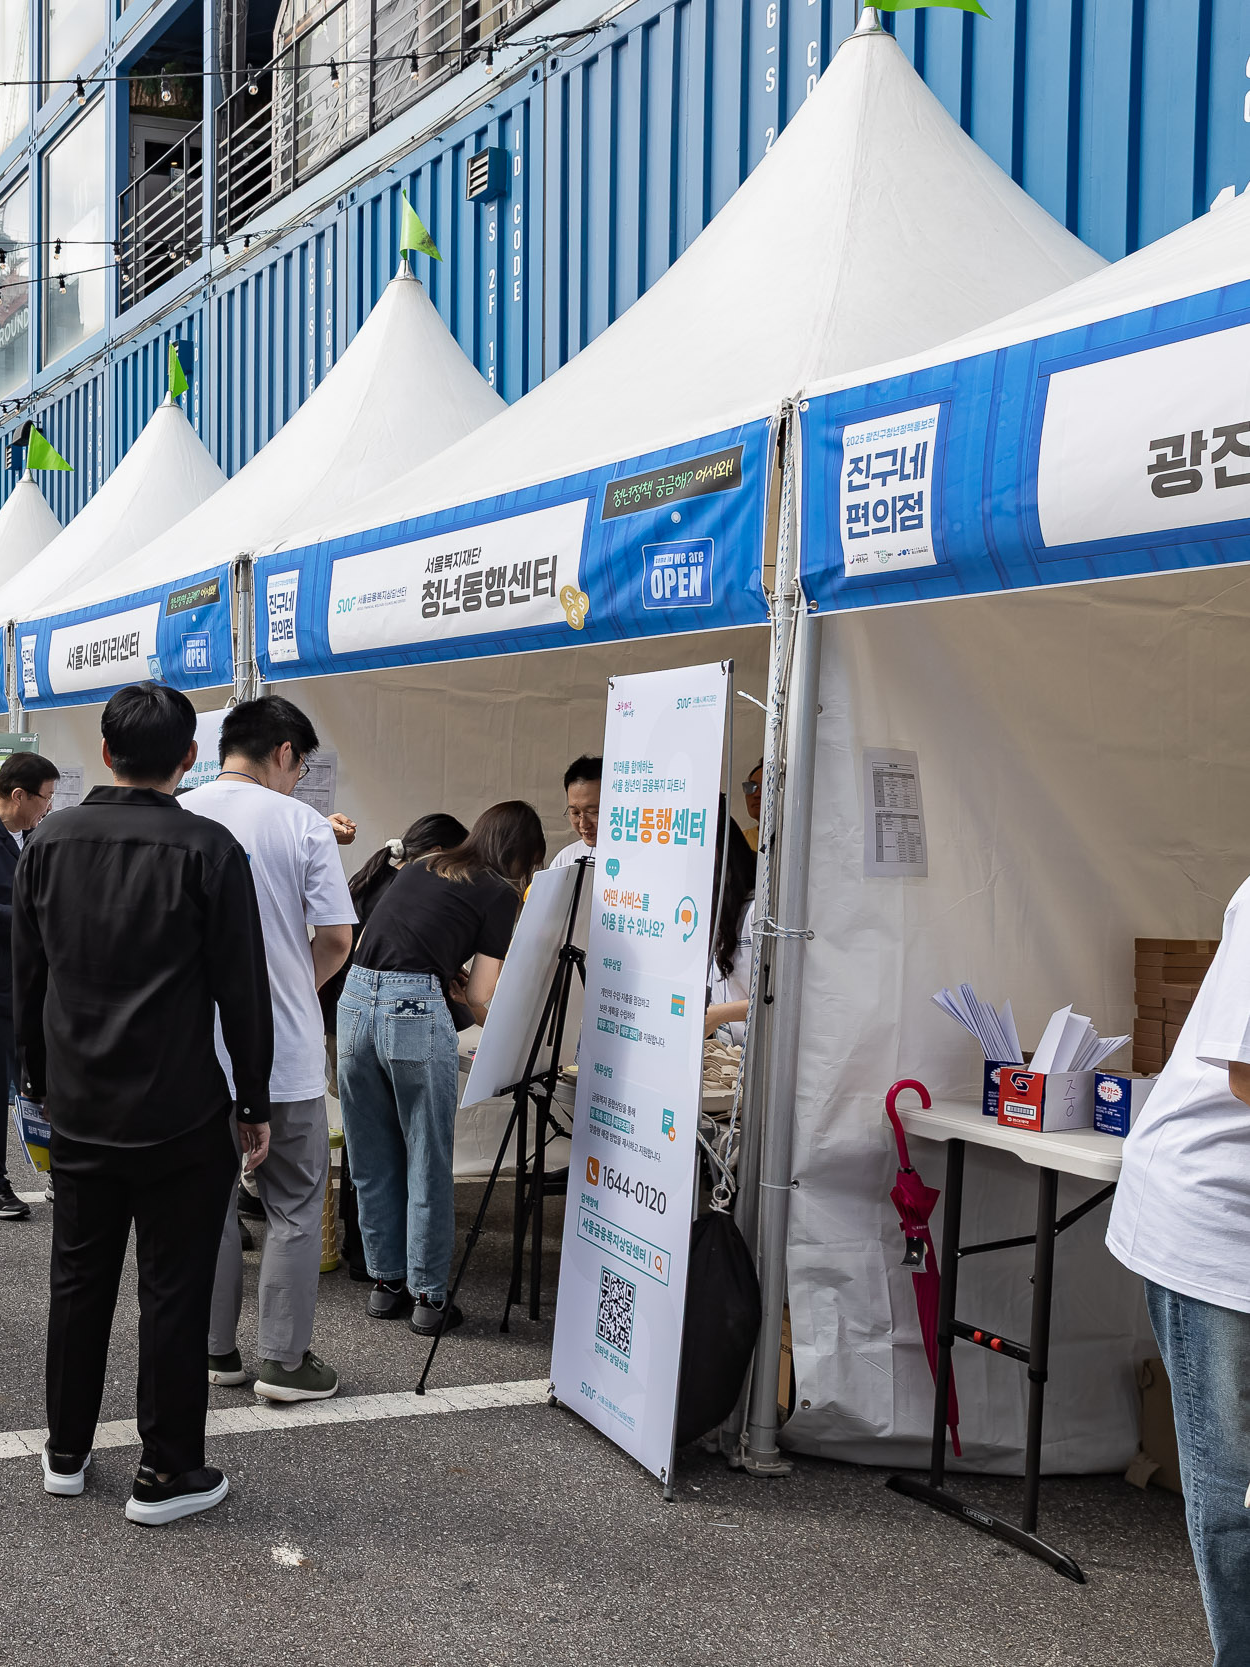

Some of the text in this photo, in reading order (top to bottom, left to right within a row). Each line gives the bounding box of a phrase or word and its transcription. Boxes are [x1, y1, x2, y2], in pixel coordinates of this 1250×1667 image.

[513, 129, 522, 302] ID CODE
[846, 433, 865, 447] 2025
[846, 440, 929, 493] 진구네
[612, 458, 735, 508] 청년정책 궁금해? 어서와!
[845, 490, 924, 540] 편의점
[424, 546, 482, 574] 서울복지재단
[674, 552, 687, 565] we
[688, 551, 704, 564] are
[421, 554, 559, 619] 청년동행센터
[650, 565, 703, 600] OPEN
[269, 588, 296, 616] 진구네
[270, 617, 294, 642] 편의점
[66, 631, 141, 671] 서울시일자리센터
[185, 647, 207, 668] OPEN
[613, 760, 654, 774] 미래를 함께하는
[612, 778, 686, 793] 서울 청년의 금융복지 파트너
[610, 806, 707, 847] 청년동행센터
[603, 888, 650, 912] 어떤 서비스를
[601, 912, 665, 938] 이용 할 수 있나요?
[602, 1165, 667, 1215] 1644-0120
[581, 1217, 647, 1265] 서울금융복지상담센터
[594, 1342, 629, 1374] 인터넷 상담신청
